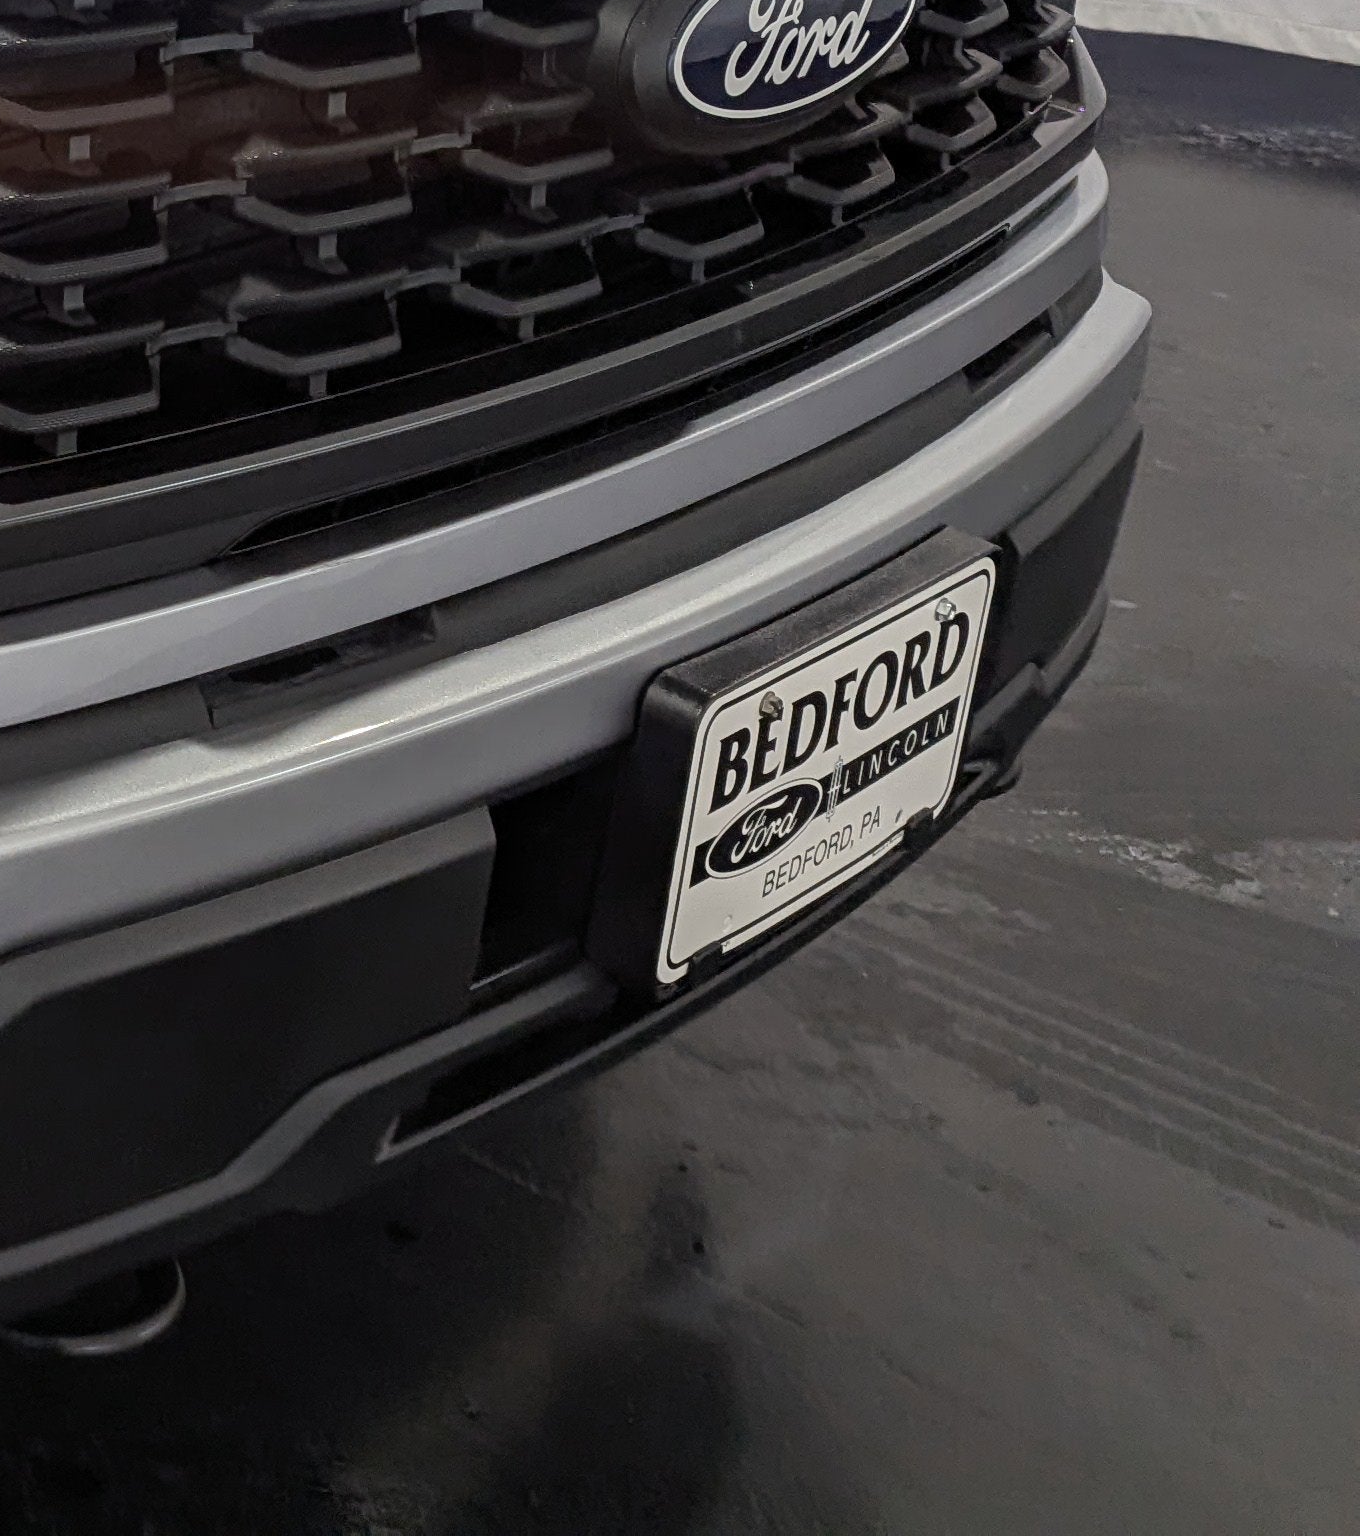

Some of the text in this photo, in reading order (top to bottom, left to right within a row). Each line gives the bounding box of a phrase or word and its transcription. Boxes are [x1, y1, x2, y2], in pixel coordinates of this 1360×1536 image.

[707, 611, 970, 815] BEDFORD
[730, 709, 950, 864] Ford LINCOLN
[761, 823, 855, 898] BEDFORD,
[859, 805, 881, 840] PA
